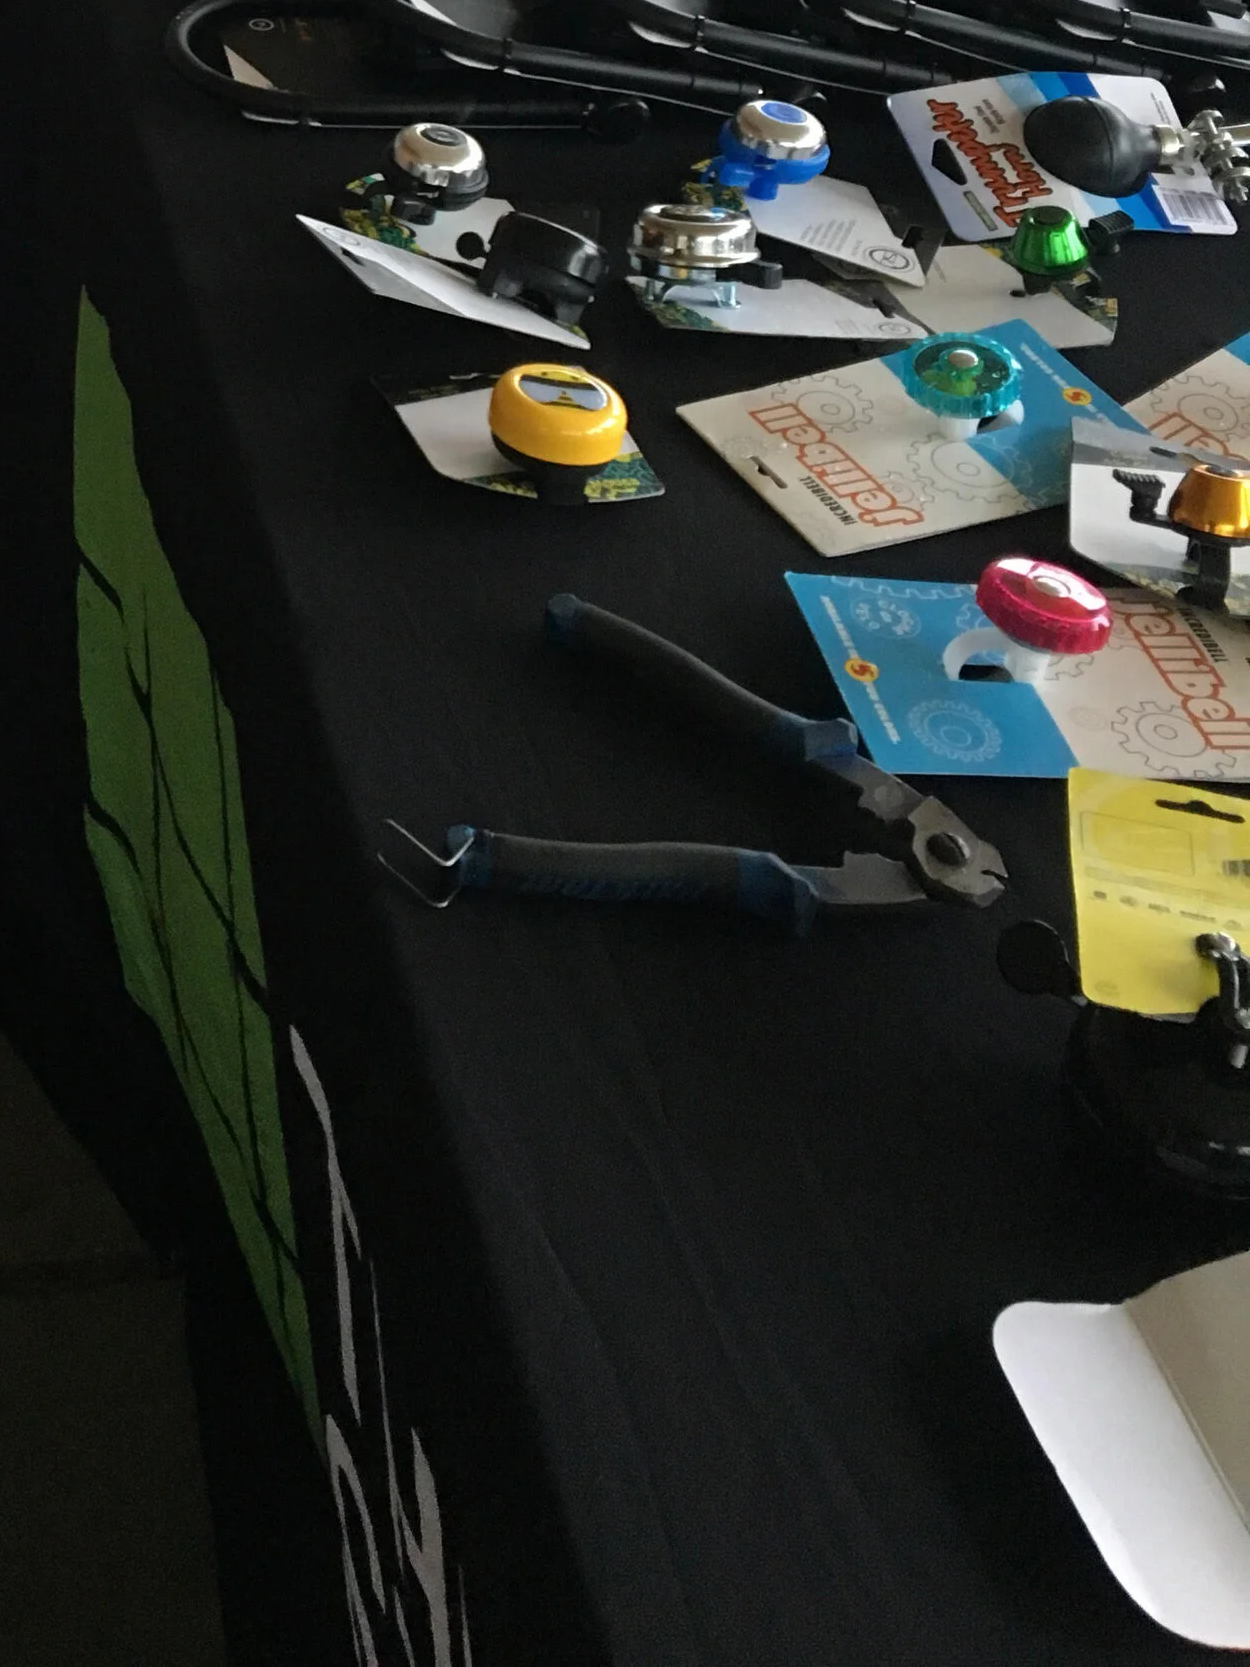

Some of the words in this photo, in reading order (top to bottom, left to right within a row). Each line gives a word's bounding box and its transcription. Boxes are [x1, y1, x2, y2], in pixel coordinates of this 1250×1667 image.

[927, 98, 1020, 227] Trumpeter
[1002, 144, 1053, 200] Horn
[799, 476, 857, 527] INCREDIBELL
